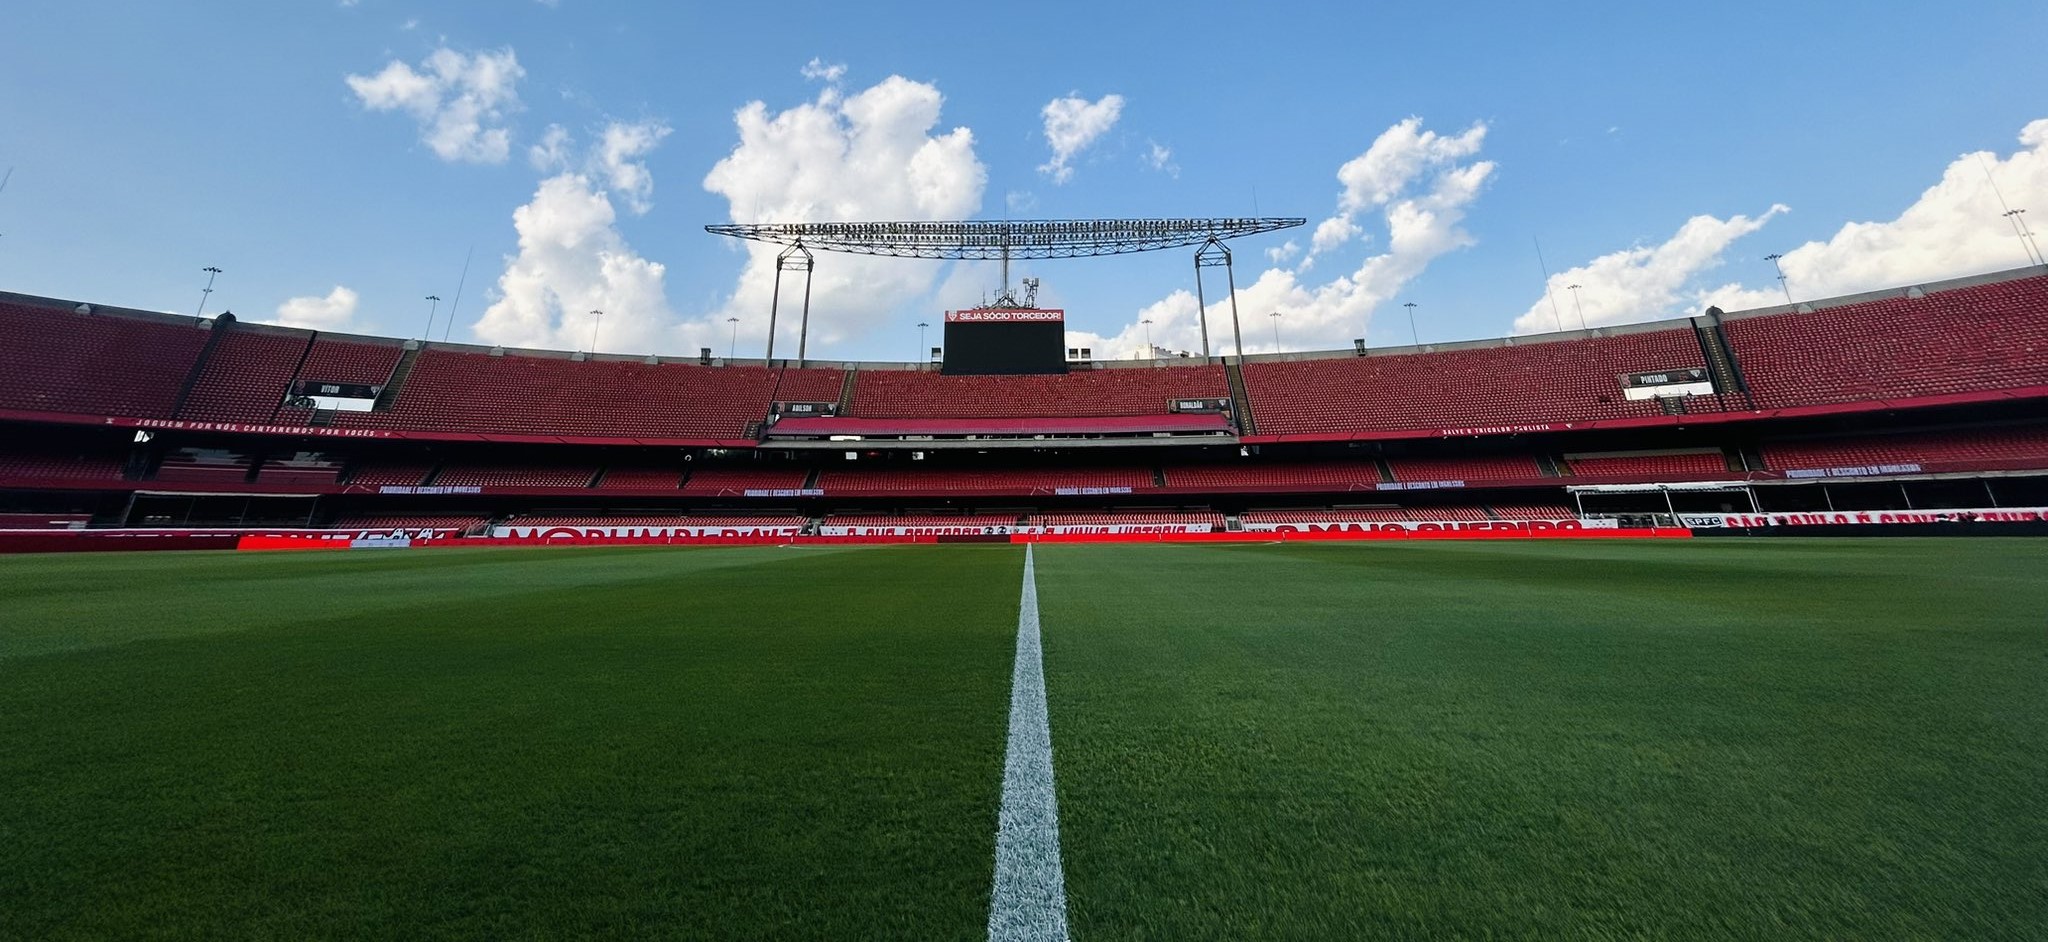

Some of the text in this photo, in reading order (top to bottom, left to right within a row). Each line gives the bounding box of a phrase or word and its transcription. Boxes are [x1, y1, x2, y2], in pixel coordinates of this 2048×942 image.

[960, 311, 1061, 320] SEJA SÓCIO TORCEDOR!
[1640, 374, 1668, 384] PINTADO
[136, 419, 184, 428] JOGUEM
[190, 422, 211, 430] POR
[243, 425, 314, 435] CANTAREMOS
[1475, 426, 1511, 434] TRICOLOR
[1687, 516, 1720, 526] SPFC
